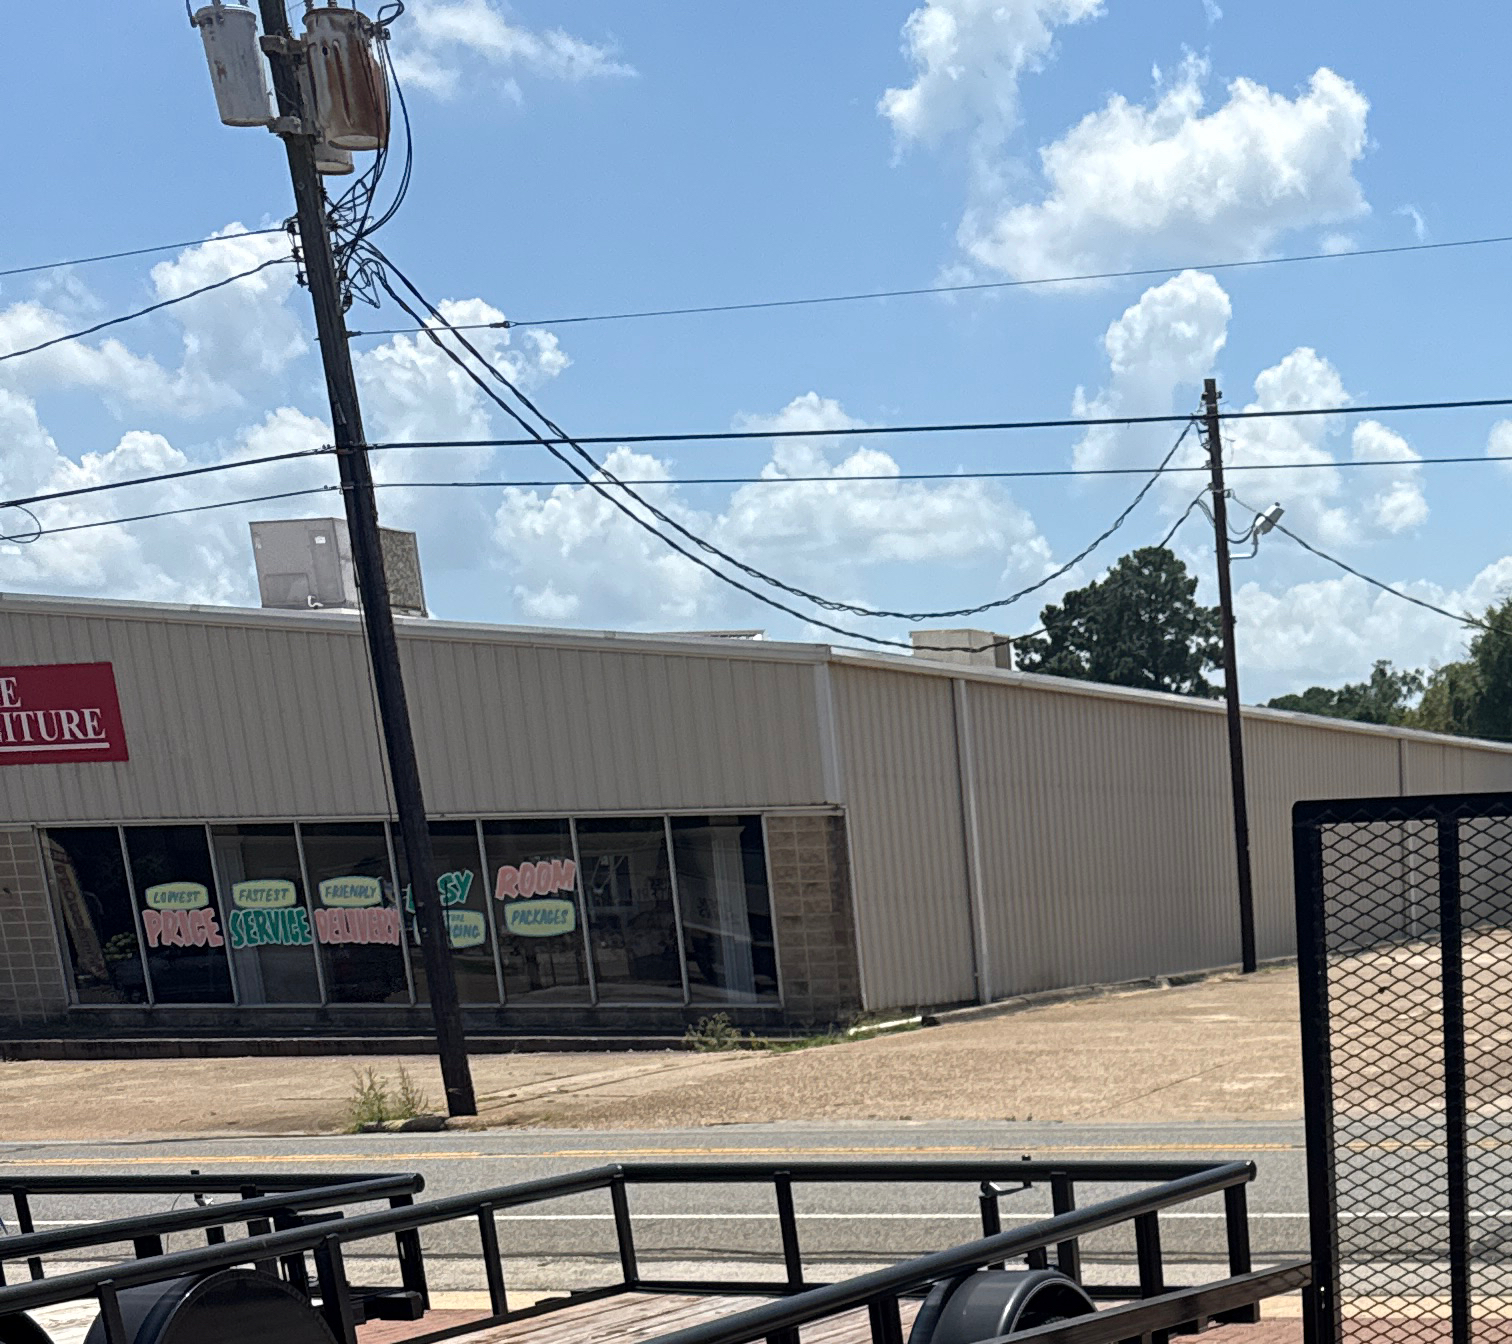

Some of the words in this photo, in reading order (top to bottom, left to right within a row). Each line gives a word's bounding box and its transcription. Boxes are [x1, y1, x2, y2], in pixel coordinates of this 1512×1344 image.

[0, 708, 106, 742] ITURE
[238, 887, 290, 903] FASTEST
[324, 883, 378, 900] FRIENDLY
[495, 859, 577, 900] ROOM
[153, 890, 200, 904] LOWEST
[142, 907, 224, 947] PRICE
[229, 906, 313, 949] SERVICE
[314, 907, 400, 946] DELIVERY
[510, 908, 569, 926] PACKAGES
